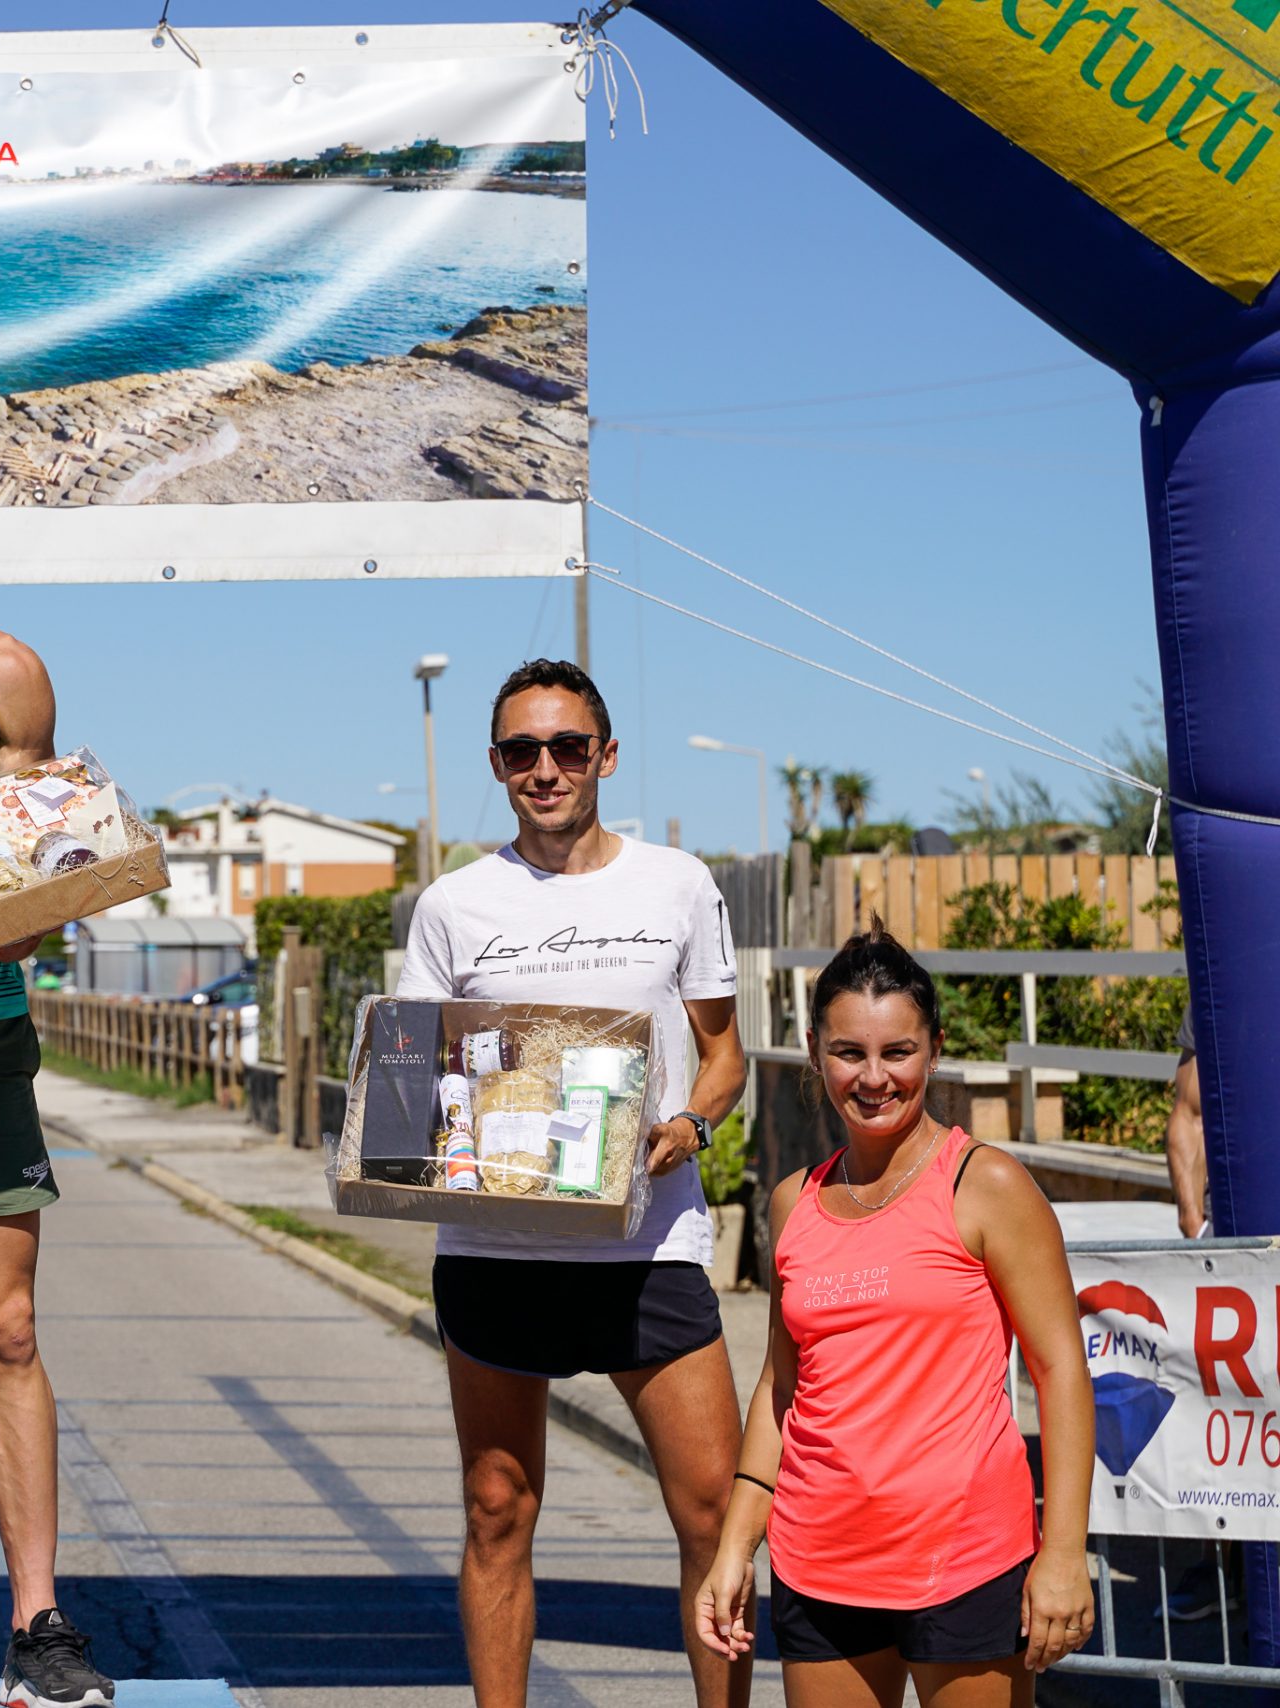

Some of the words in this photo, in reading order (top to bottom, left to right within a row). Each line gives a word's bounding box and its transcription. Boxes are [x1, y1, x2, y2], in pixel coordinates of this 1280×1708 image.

[473, 935, 529, 967] Los
[537, 925, 673, 954] Angeles
[516, 963, 548, 976] THINKING
[551, 960, 574, 973] ABOUT
[577, 958, 590, 970] THE
[594, 956, 628, 969] WEEKEND
[805, 1273, 847, 1289] CAN'T
[852, 1265, 890, 1283] STOP
